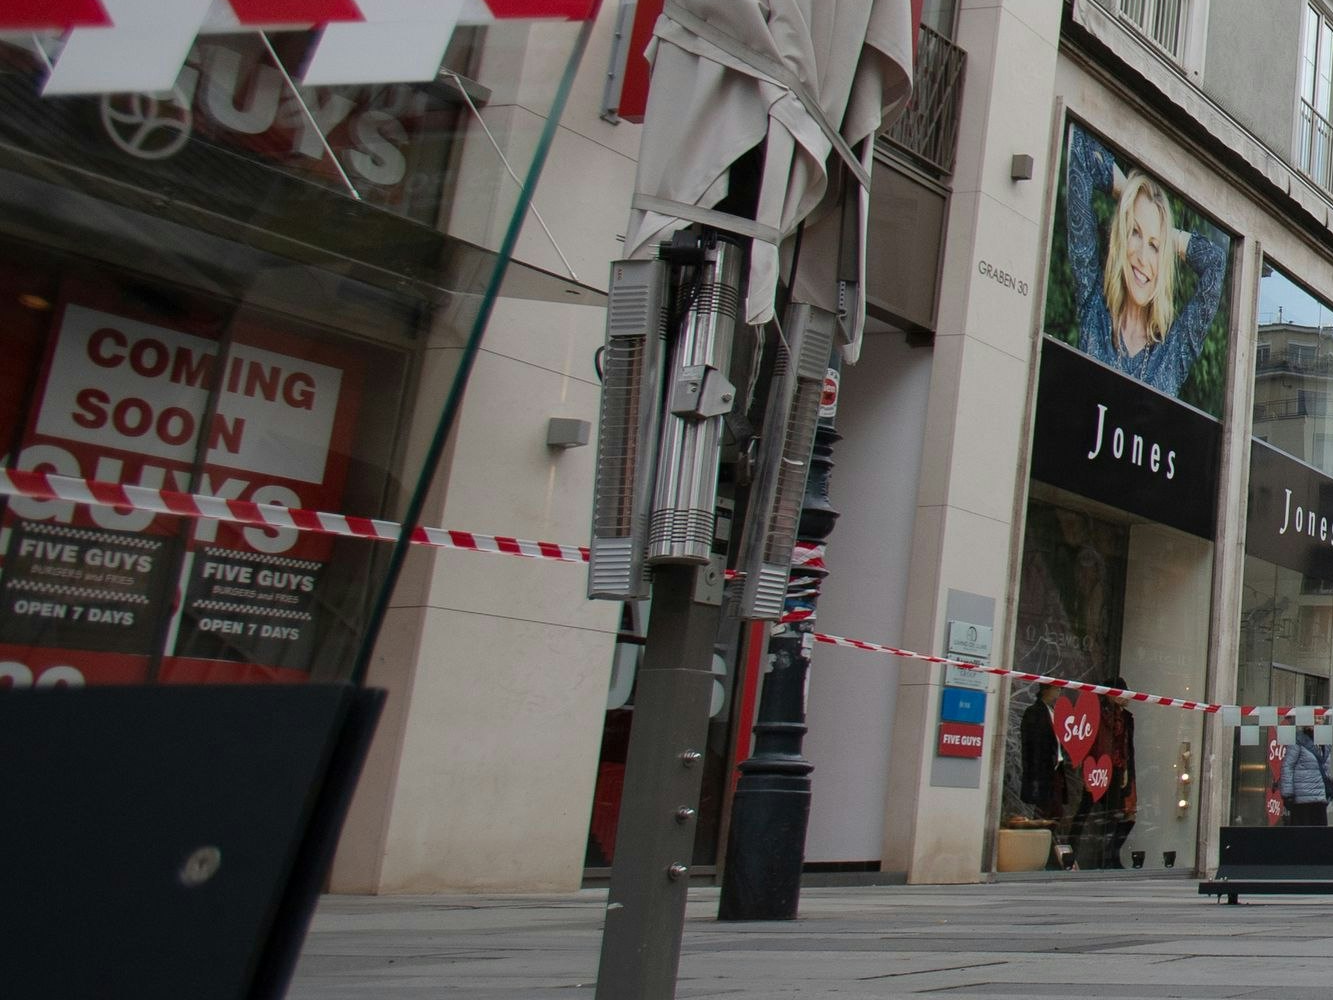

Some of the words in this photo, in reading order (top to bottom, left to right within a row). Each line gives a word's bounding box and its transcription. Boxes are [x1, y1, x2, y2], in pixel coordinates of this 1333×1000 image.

[978, 258, 1016, 292] GRABEN
[1017, 278, 1029, 298] 30
[86, 327, 317, 412] COMING
[71, 387, 247, 455] SOON
[1087, 402, 1178, 481] Jones
[19, 538, 78, 564] FIVE
[84, 548, 154, 574] GUYS
[202, 561, 253, 583] FIVE
[257, 569, 315, 592] GUYS
[14, 599, 68, 619] OPEN
[72, 606, 84, 619] 7
[87, 608, 135, 626] DAYS
[199, 617, 244, 634] OPEN
[248, 623, 258, 635] 7
[260, 624, 301, 641] DAYS
[943, 733, 961, 745] FIVE
[961, 735, 982, 747] GUYS
[1063, 713, 1094, 743] Sale
